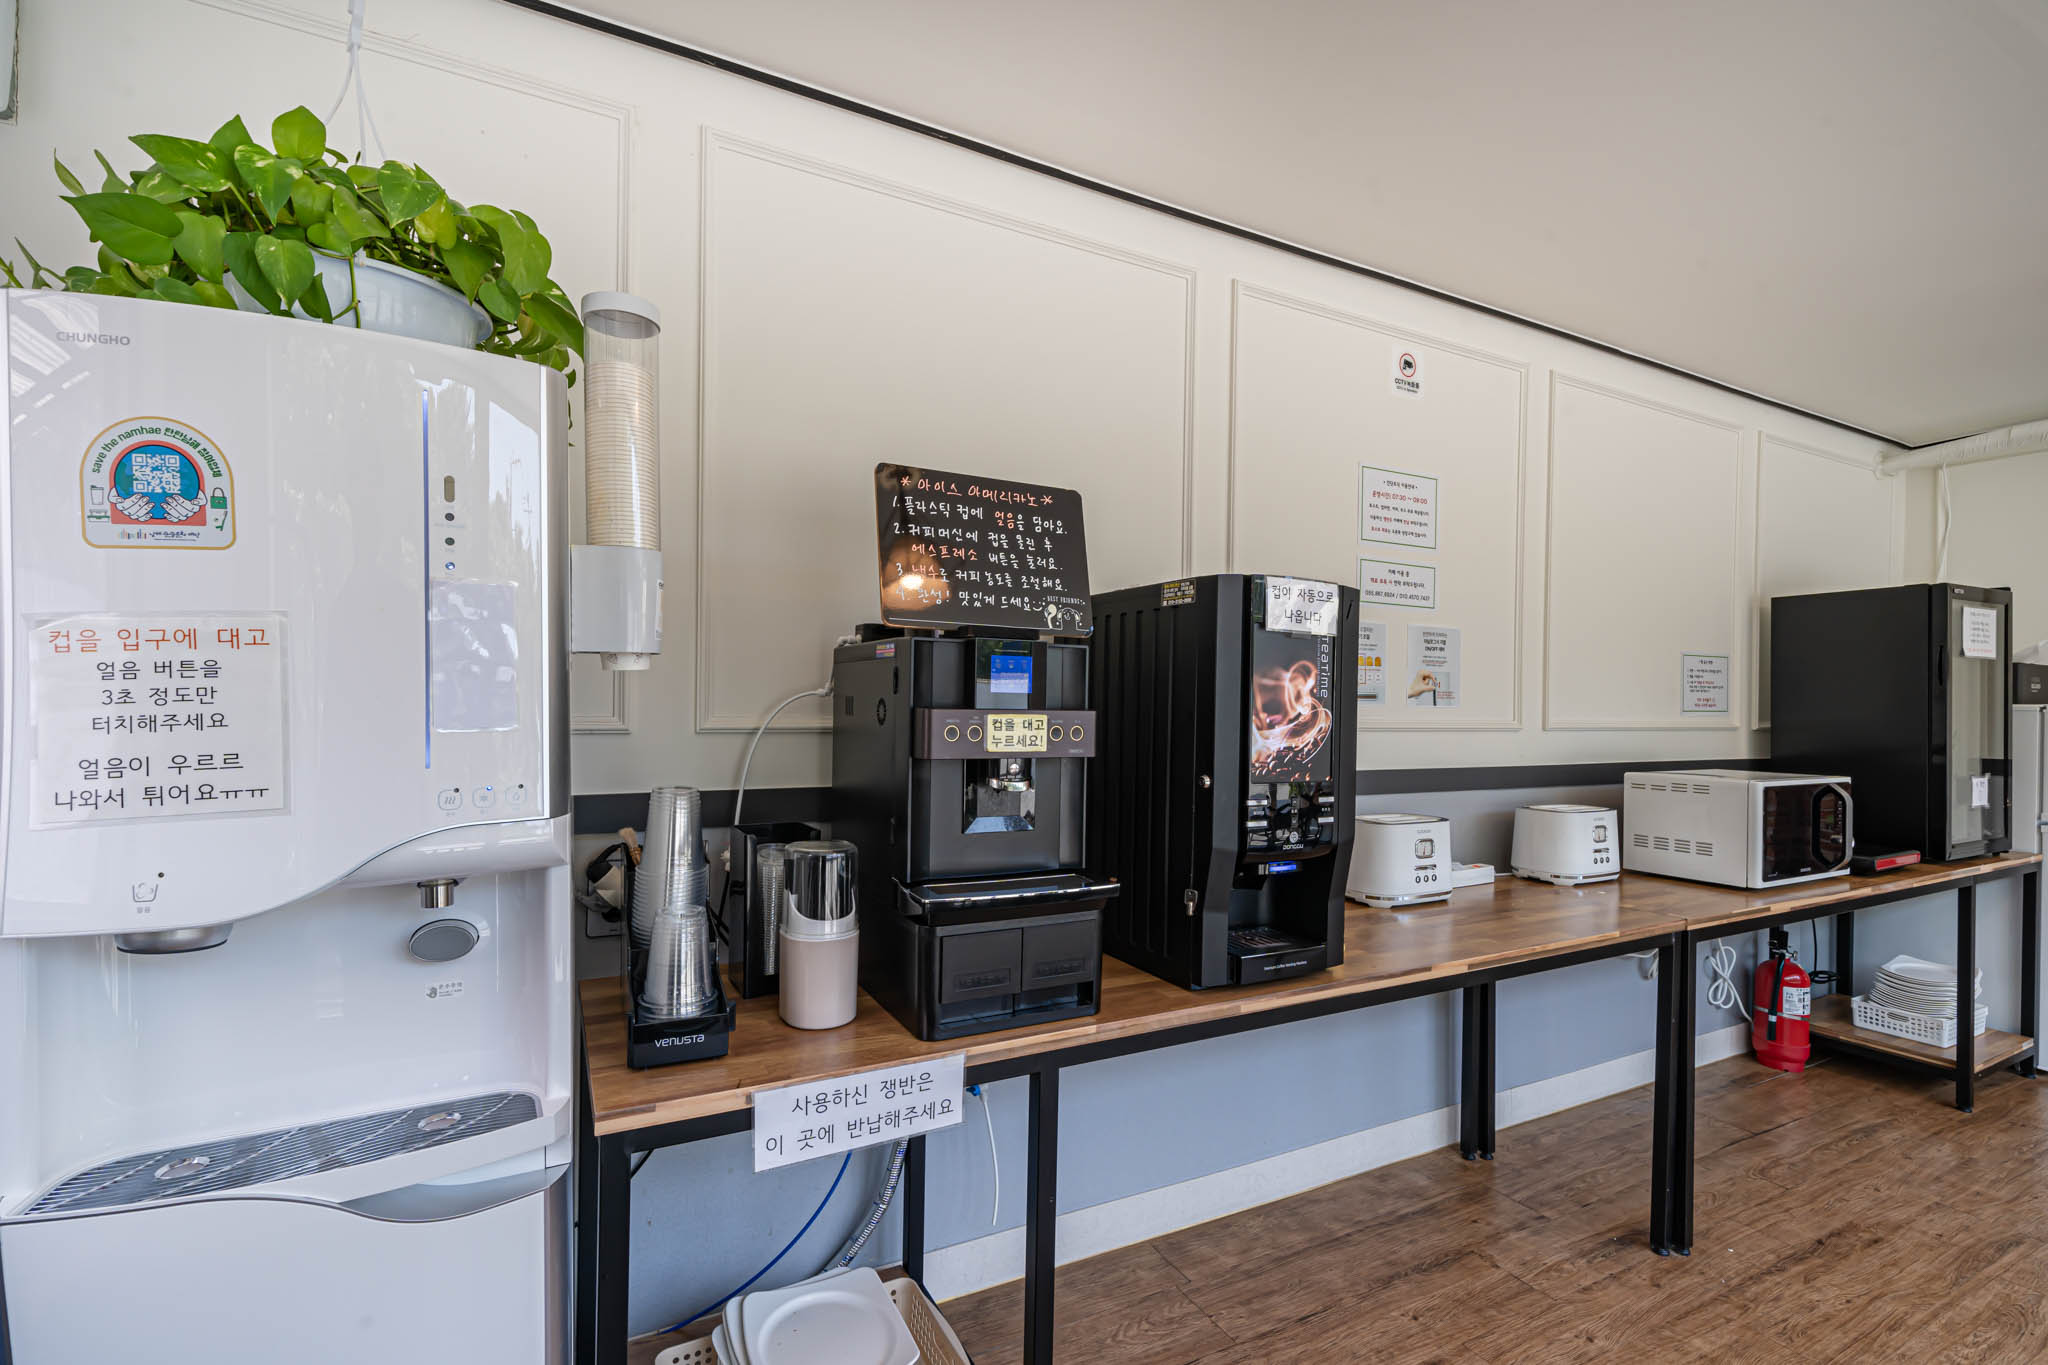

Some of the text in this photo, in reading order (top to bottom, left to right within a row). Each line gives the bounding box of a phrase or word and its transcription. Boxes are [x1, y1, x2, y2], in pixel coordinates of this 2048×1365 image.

[56, 331, 130, 346] CHUNGHO
[92, 452, 107, 474] save
[102, 436, 119, 452] the
[118, 425, 162, 442] namhae
[918, 478, 1039, 507] 아이스 아메리카노
[892, 496, 1067, 534] 1. 플라스틱 컵에 얼음을 담아요.
[893, 522, 905, 534] 2.
[988, 531, 1008, 549] 컵을
[1044, 539, 1053, 552] 후
[911, 543, 1063, 572] 에스프레소 버튼을 눌러요.
[955, 569, 980, 582] 커피
[984, 571, 1013, 586] 농도를
[1021, 575, 1068, 592] 조절해요.
[959, 591, 995, 608] 맛있게
[1001, 596, 1031, 611] 드세요
[1272, 585, 1334, 604] 컵이 자동으로
[1285, 609, 1322, 624] 나옵니다
[49, 627, 270, 653] 컵을 입구에 대고
[97, 659, 222, 680] 얼음 버튼을
[102, 686, 218, 706] 3초 정도만
[92, 713, 229, 735] 터치해주세요
[992, 718, 1015, 732] 컵을
[1022, 718, 1045, 732] 대고
[991, 734, 1044, 748] 누르세요!
[78, 753, 244, 780] 얼음이 우르르
[54, 784, 269, 811] 나와서 튀어요ㅠㅠ
[792, 1072, 934, 1116] 사용하신 쟁반은
[766, 1098, 954, 1155] 이 곳에 반납해주세요
